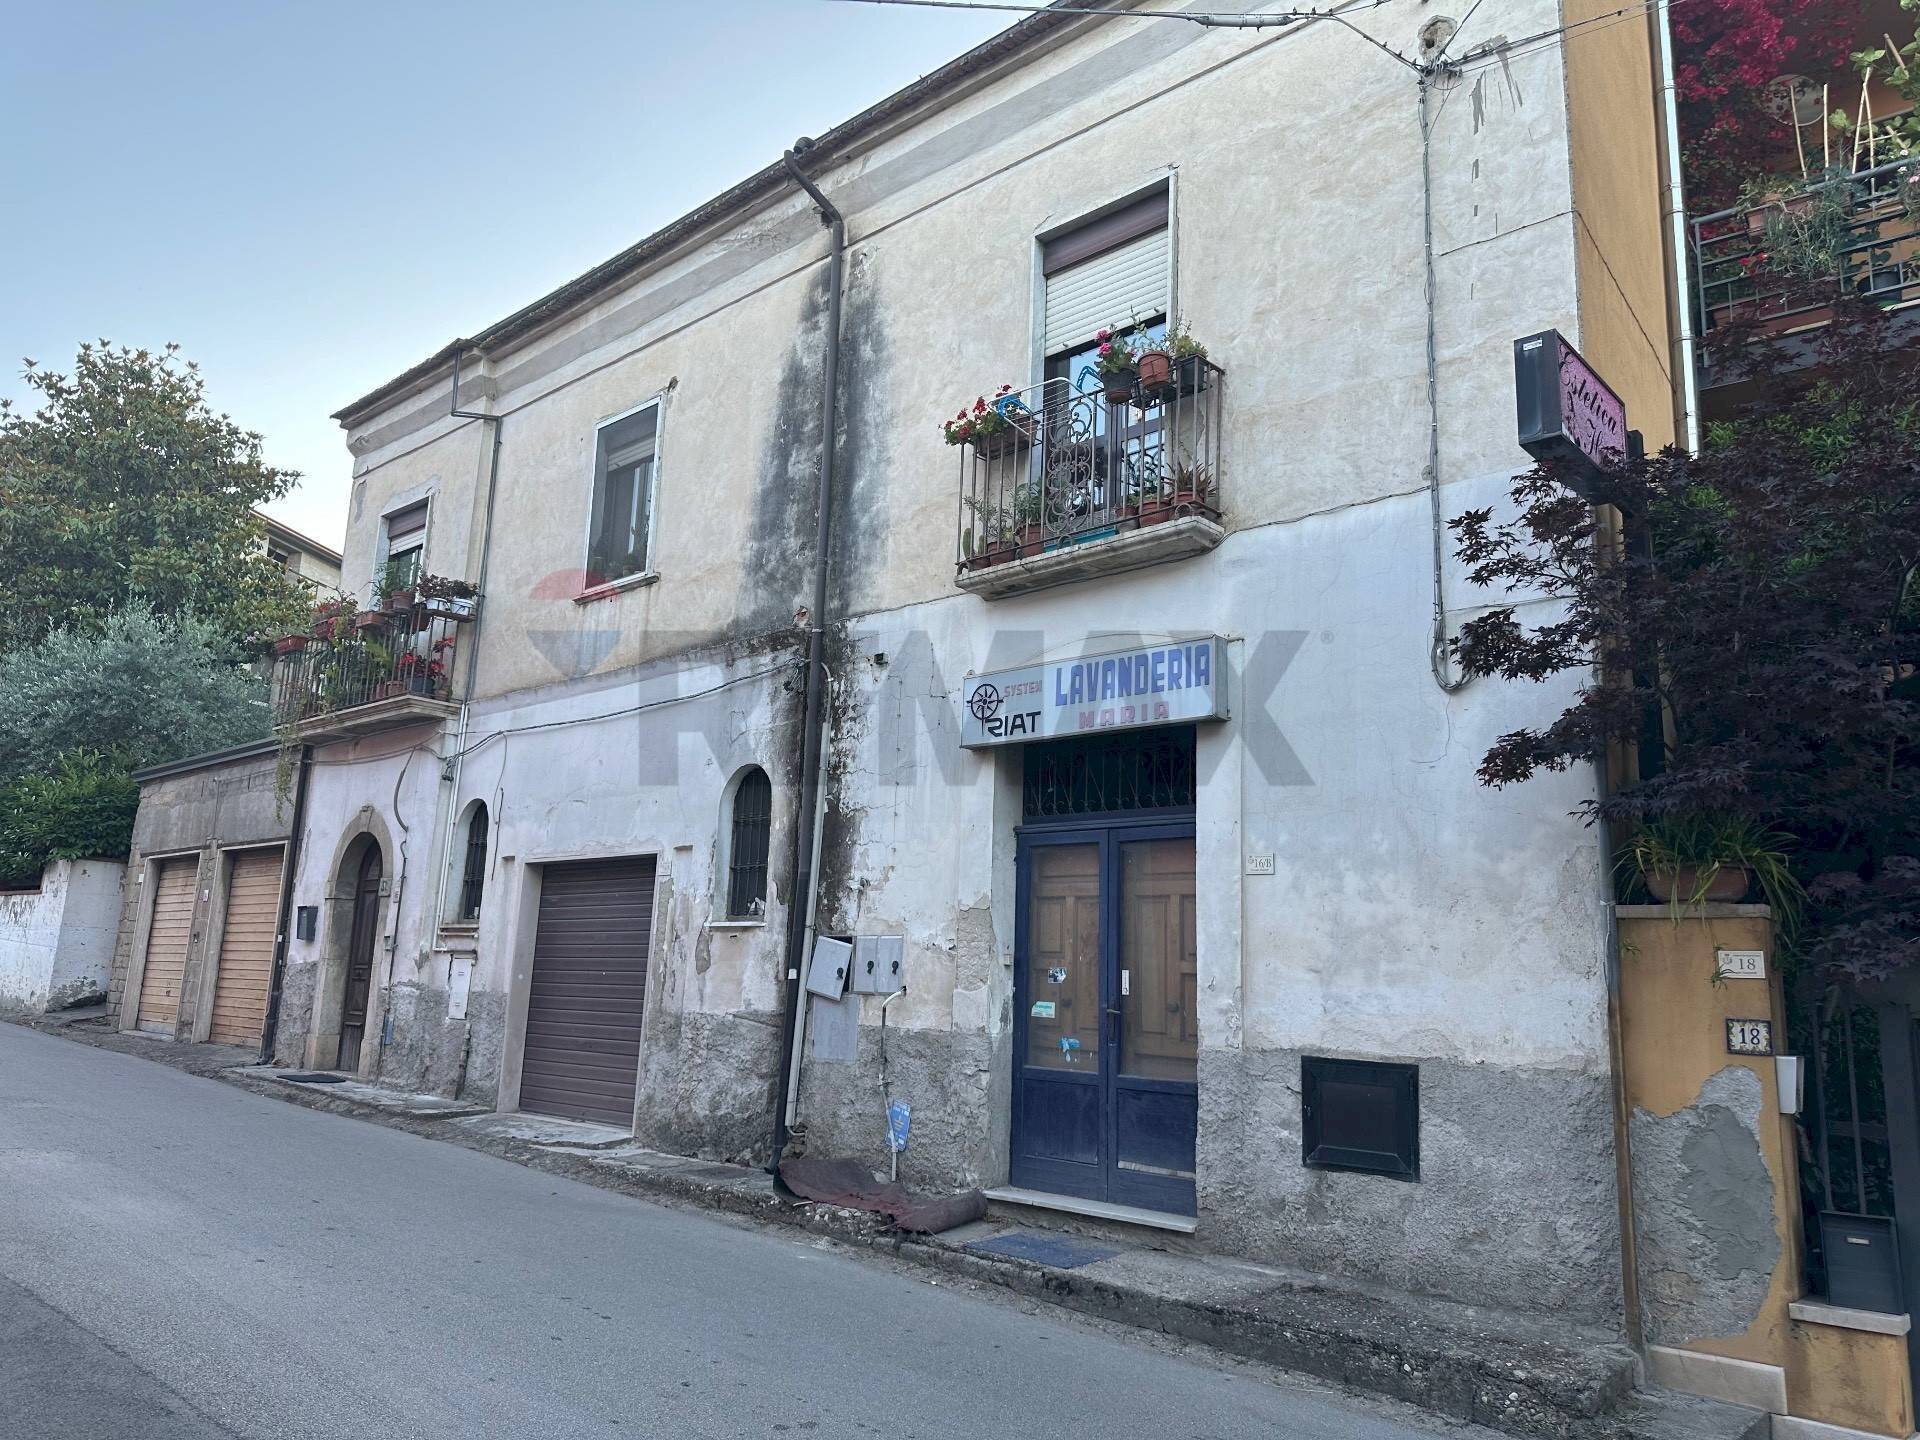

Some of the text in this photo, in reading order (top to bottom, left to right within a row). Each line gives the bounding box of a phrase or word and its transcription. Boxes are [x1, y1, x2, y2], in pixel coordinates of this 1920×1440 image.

[1056, 645, 1210, 706] LAVANDERIA
[1003, 681, 1042, 697] SYSTEM
[1079, 702, 1169, 729] MARIA
[1739, 958, 1756, 970] 18
[1738, 1028, 1760, 1045] 18
